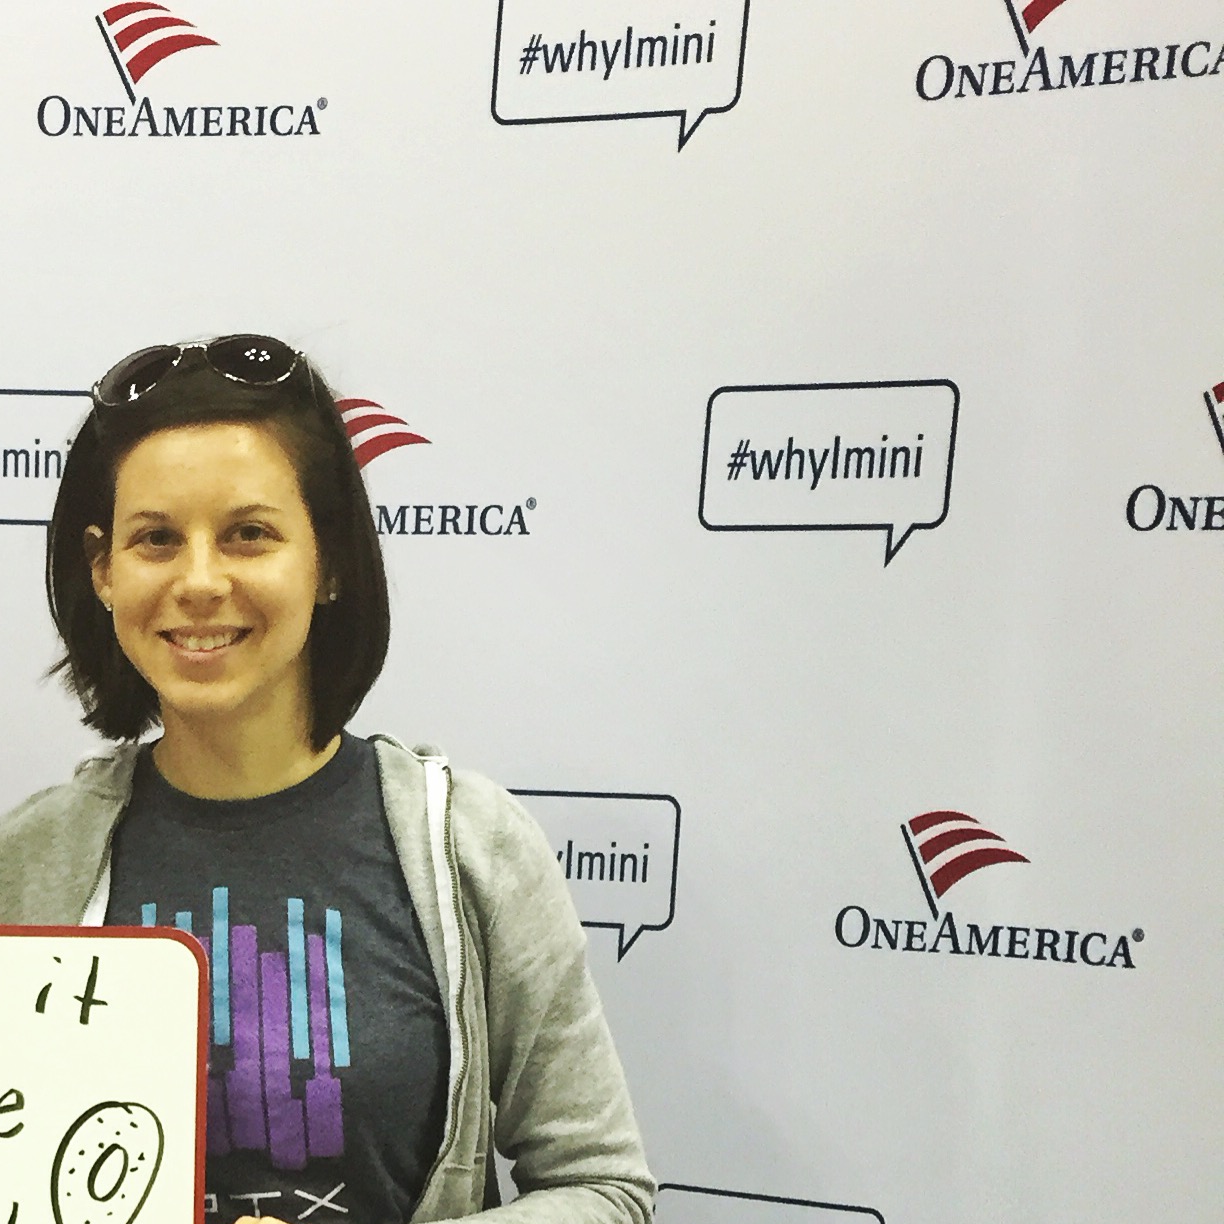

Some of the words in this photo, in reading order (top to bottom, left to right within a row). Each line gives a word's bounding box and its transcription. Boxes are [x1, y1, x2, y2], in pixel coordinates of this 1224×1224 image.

[519, 19, 716, 81] #whyImini
[726, 433, 925, 491] #whyImini
[35, 955, 109, 1026] it
